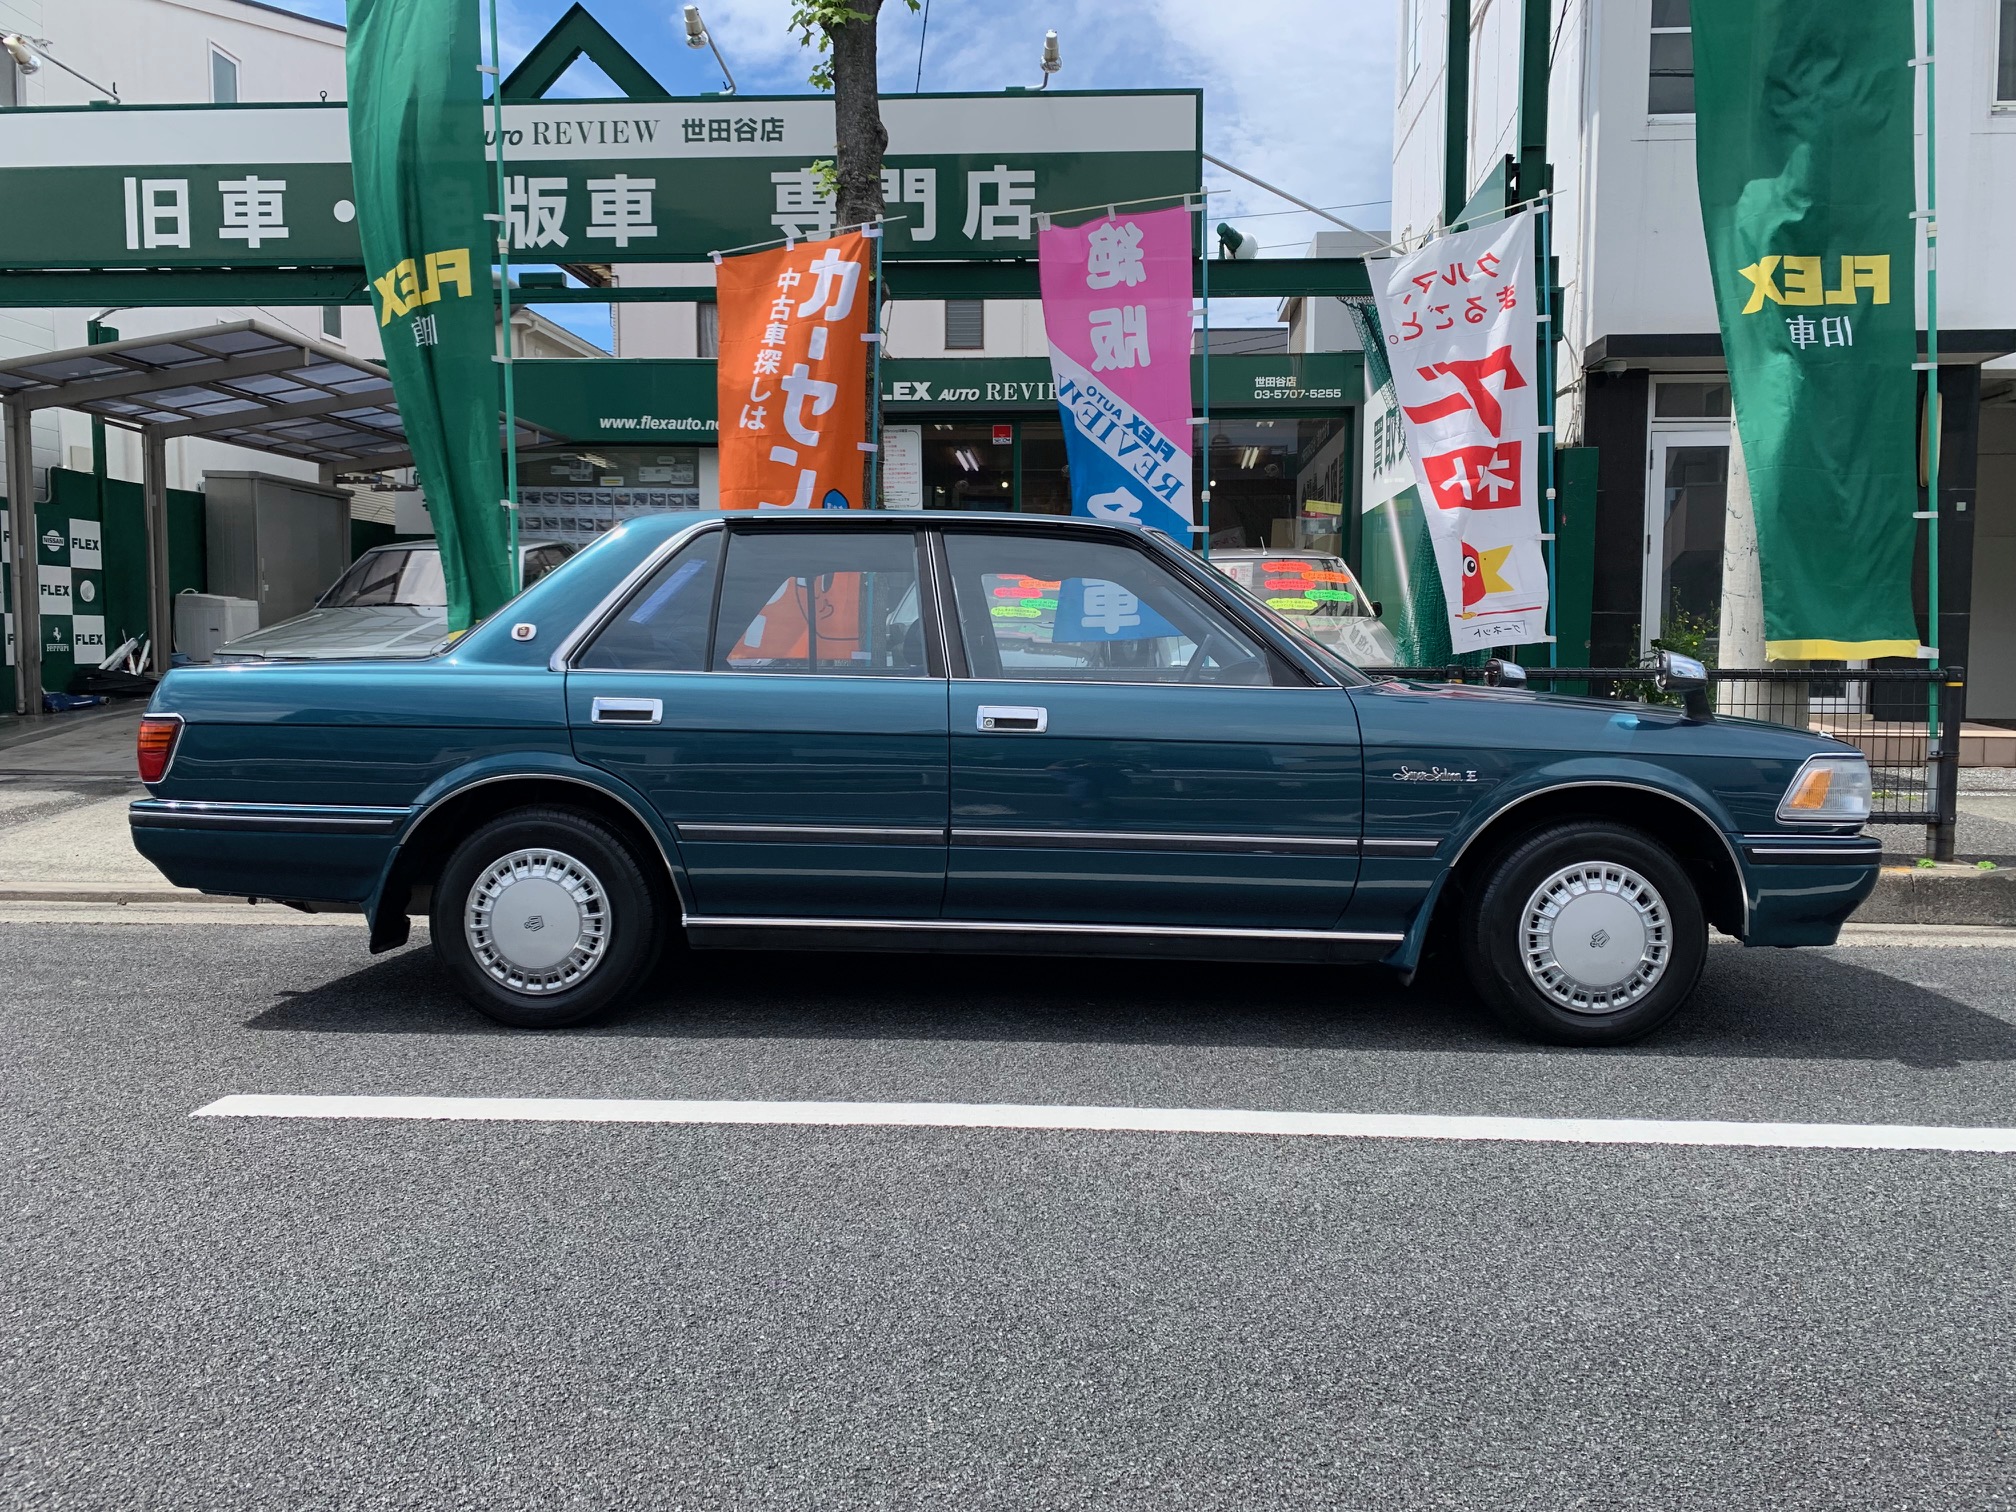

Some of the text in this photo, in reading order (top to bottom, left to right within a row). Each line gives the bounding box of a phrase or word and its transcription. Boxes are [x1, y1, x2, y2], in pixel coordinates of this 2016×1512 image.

[484, 119, 661, 146] UTO REVIEW
[681, 116, 785, 143] 世田谷店
[123, 164, 1036, 250] 旧車・版車 専門店
[738, 267, 801, 430] 中古車探しは
[1254, 376, 1297, 388] 世田谷店
[937, 388, 980, 401] AUTO
[985, 382, 1058, 401] REVIE
[1253, 388, 1342, 399] 03-5707-5255
[599, 415, 719, 431] www.flexauto.ne
[42, 536, 65, 546] NISSAN
[71, 537, 99, 551] FLEX
[40, 584, 70, 597] FLEX
[75, 633, 104, 646] FLEX
[46, 643, 69, 652] Ferrari
[1466, 770, 1479, 782] E
